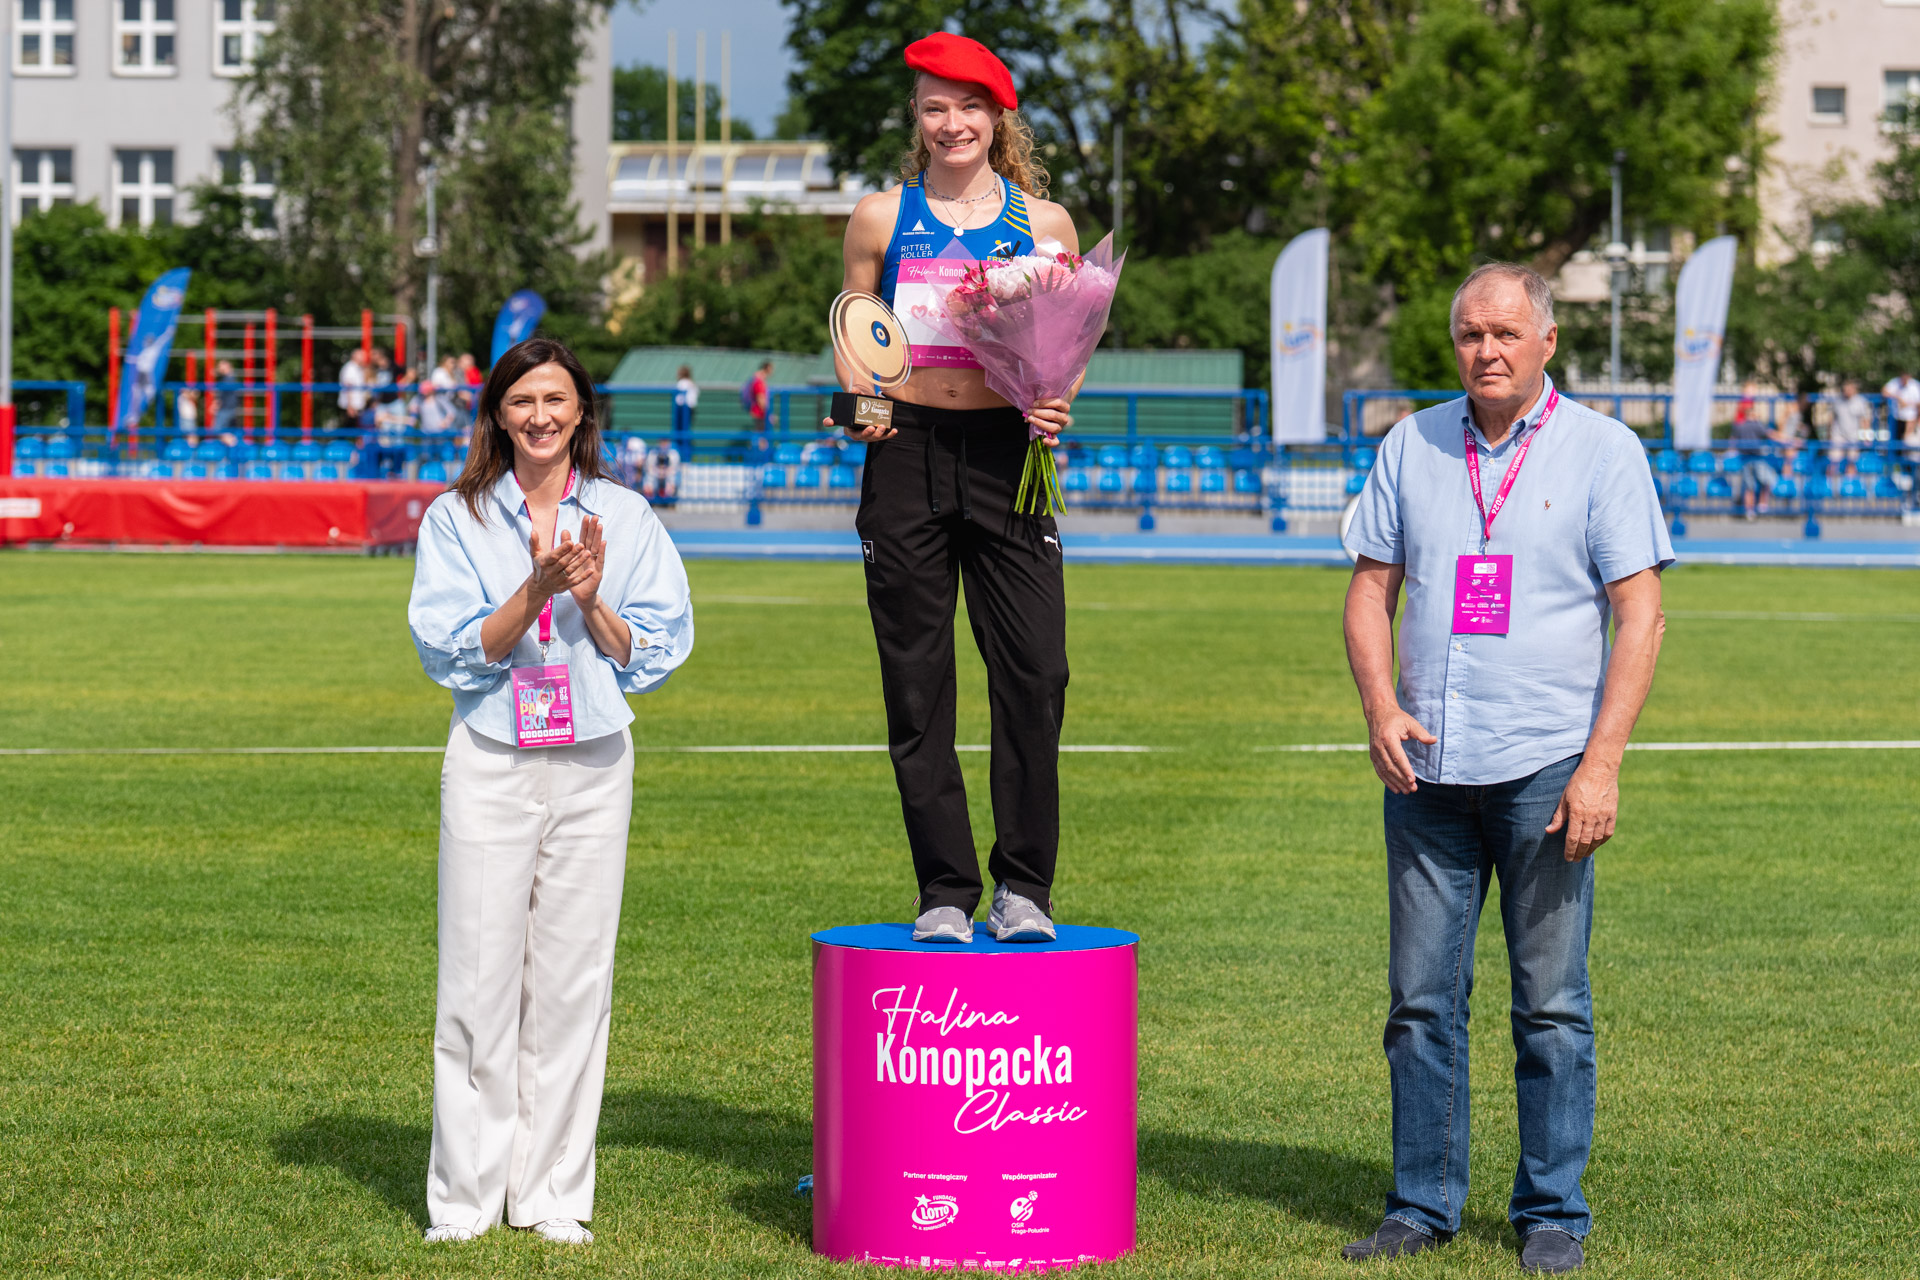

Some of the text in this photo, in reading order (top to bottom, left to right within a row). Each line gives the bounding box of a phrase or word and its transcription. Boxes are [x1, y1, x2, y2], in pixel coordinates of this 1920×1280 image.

[901, 243, 931, 253] RITTER
[901, 250, 933, 260] KOLLER
[938, 265, 967, 277] Konopa
[1466, 430, 1476, 446] 202
[1491, 494, 1505, 515] 2026
[520, 703, 537, 714] PA
[521, 715, 547, 730] CKA
[872, 985, 1019, 1046] Halina
[877, 1032, 1072, 1098] Konopacka
[954, 1089, 1087, 1134] Classic
[903, 1171, 968, 1182] Partner strategiczny
[1001, 1172, 1057, 1181] Współorganizator
[920, 1205, 950, 1220] LOTTO
